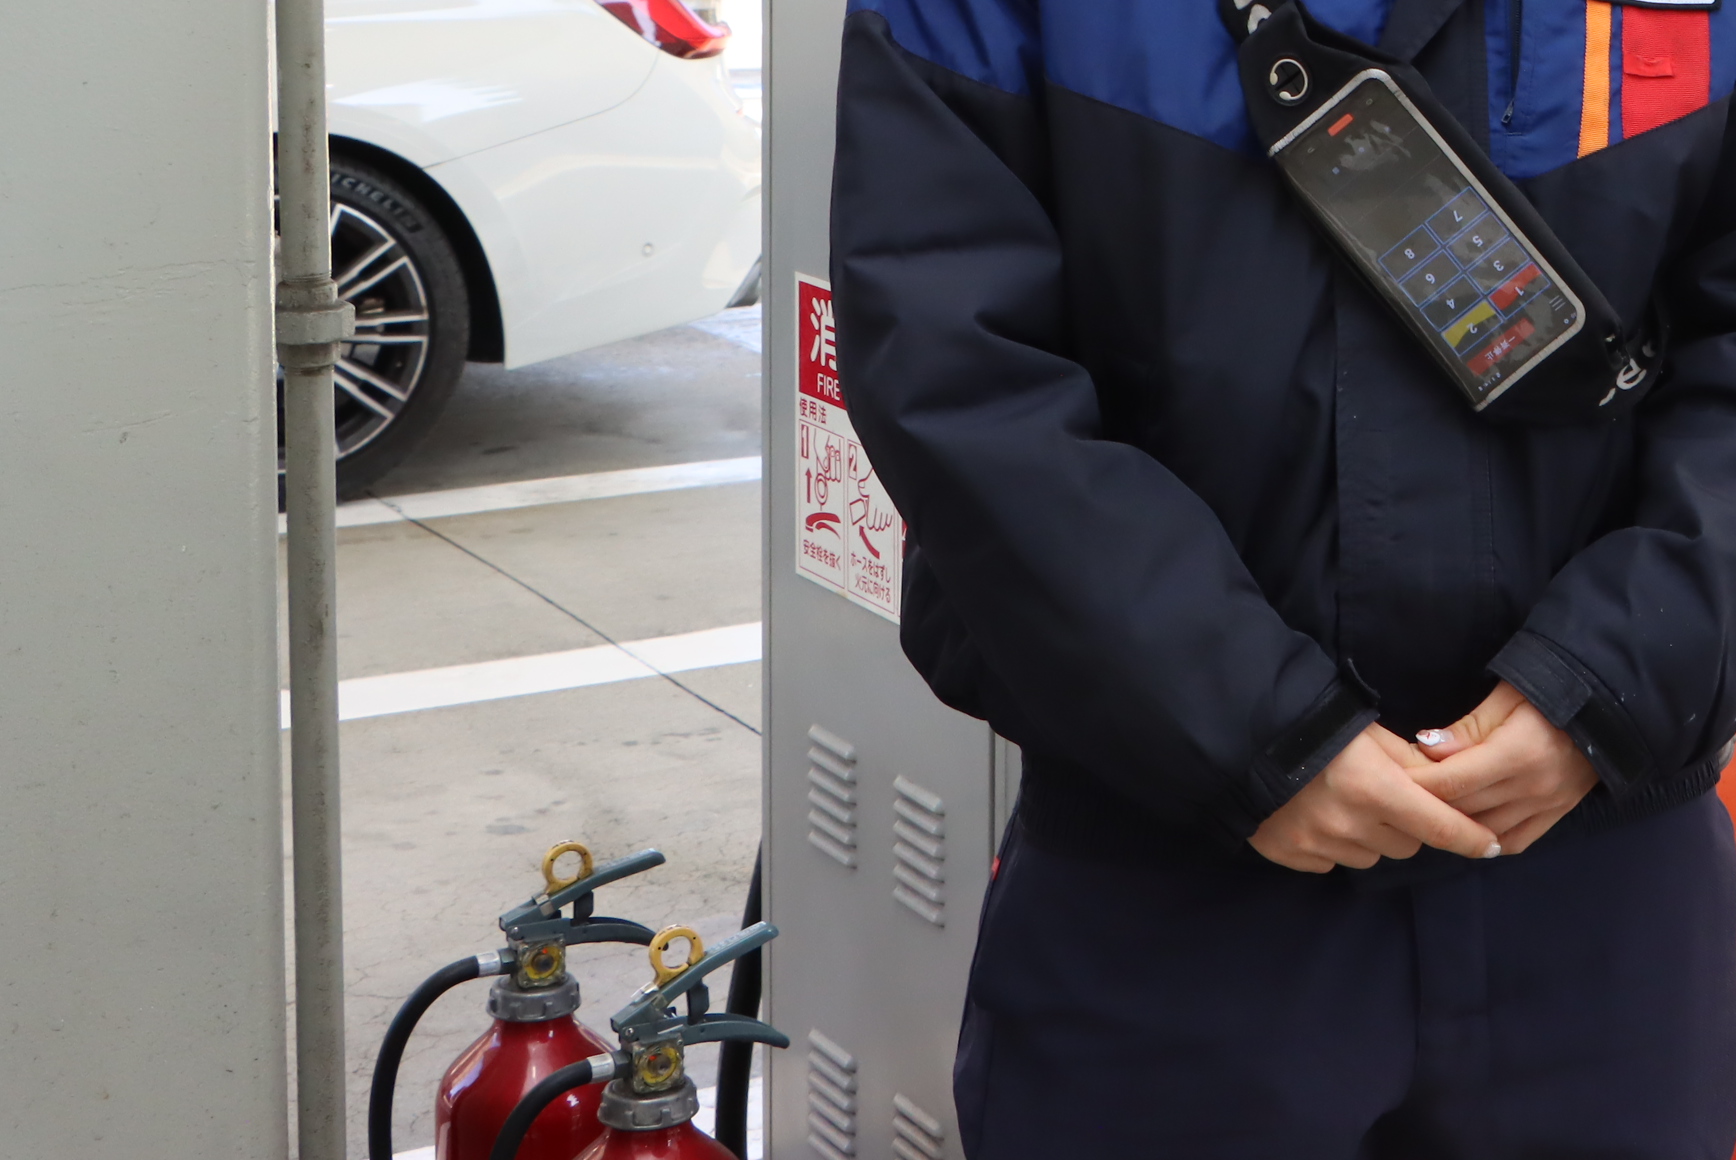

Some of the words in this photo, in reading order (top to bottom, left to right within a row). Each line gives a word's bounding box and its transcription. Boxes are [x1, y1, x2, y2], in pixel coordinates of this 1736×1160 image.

[1453, 210, 1463, 223] 7
[1472, 235, 1484, 247] 5
[1404, 248, 1416, 259] 8
[1493, 260, 1505, 272] 3
[1446, 298, 1456, 309] 4
[1466, 322, 1478, 334] 2
[816, 372, 841, 401] FIRE
[799, 397, 828, 425] 使用法
[802, 539, 842, 572] 安全栓を抜く
[850, 551, 892, 584] ホースをはずし
[855, 573, 891, 604] 火元に向ける
